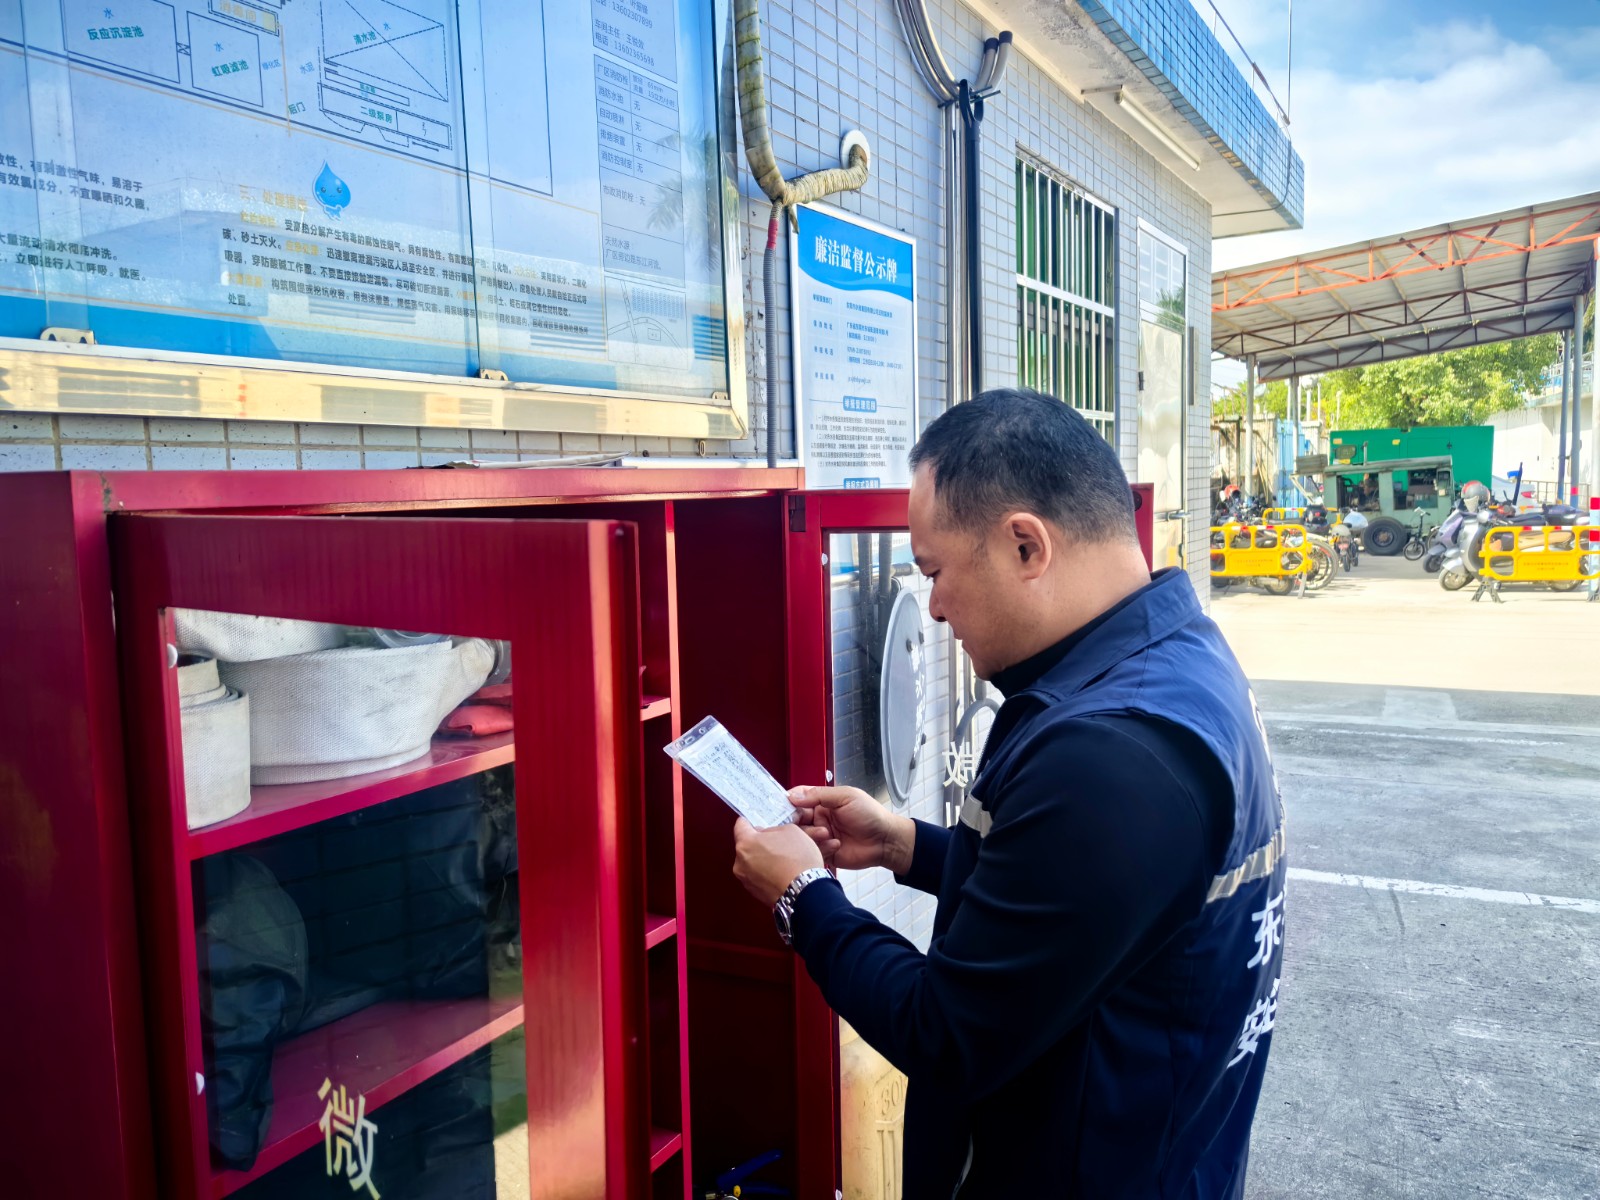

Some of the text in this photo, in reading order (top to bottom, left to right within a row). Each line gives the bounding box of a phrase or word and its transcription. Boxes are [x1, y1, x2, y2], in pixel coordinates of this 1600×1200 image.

[87, 25, 144, 40] 反应沉淀池
[211, 59, 249, 76] 虹吸滤池
[815, 235, 897, 284] 廉洁监督公示牌
[317, 1077, 381, 1200] 微
